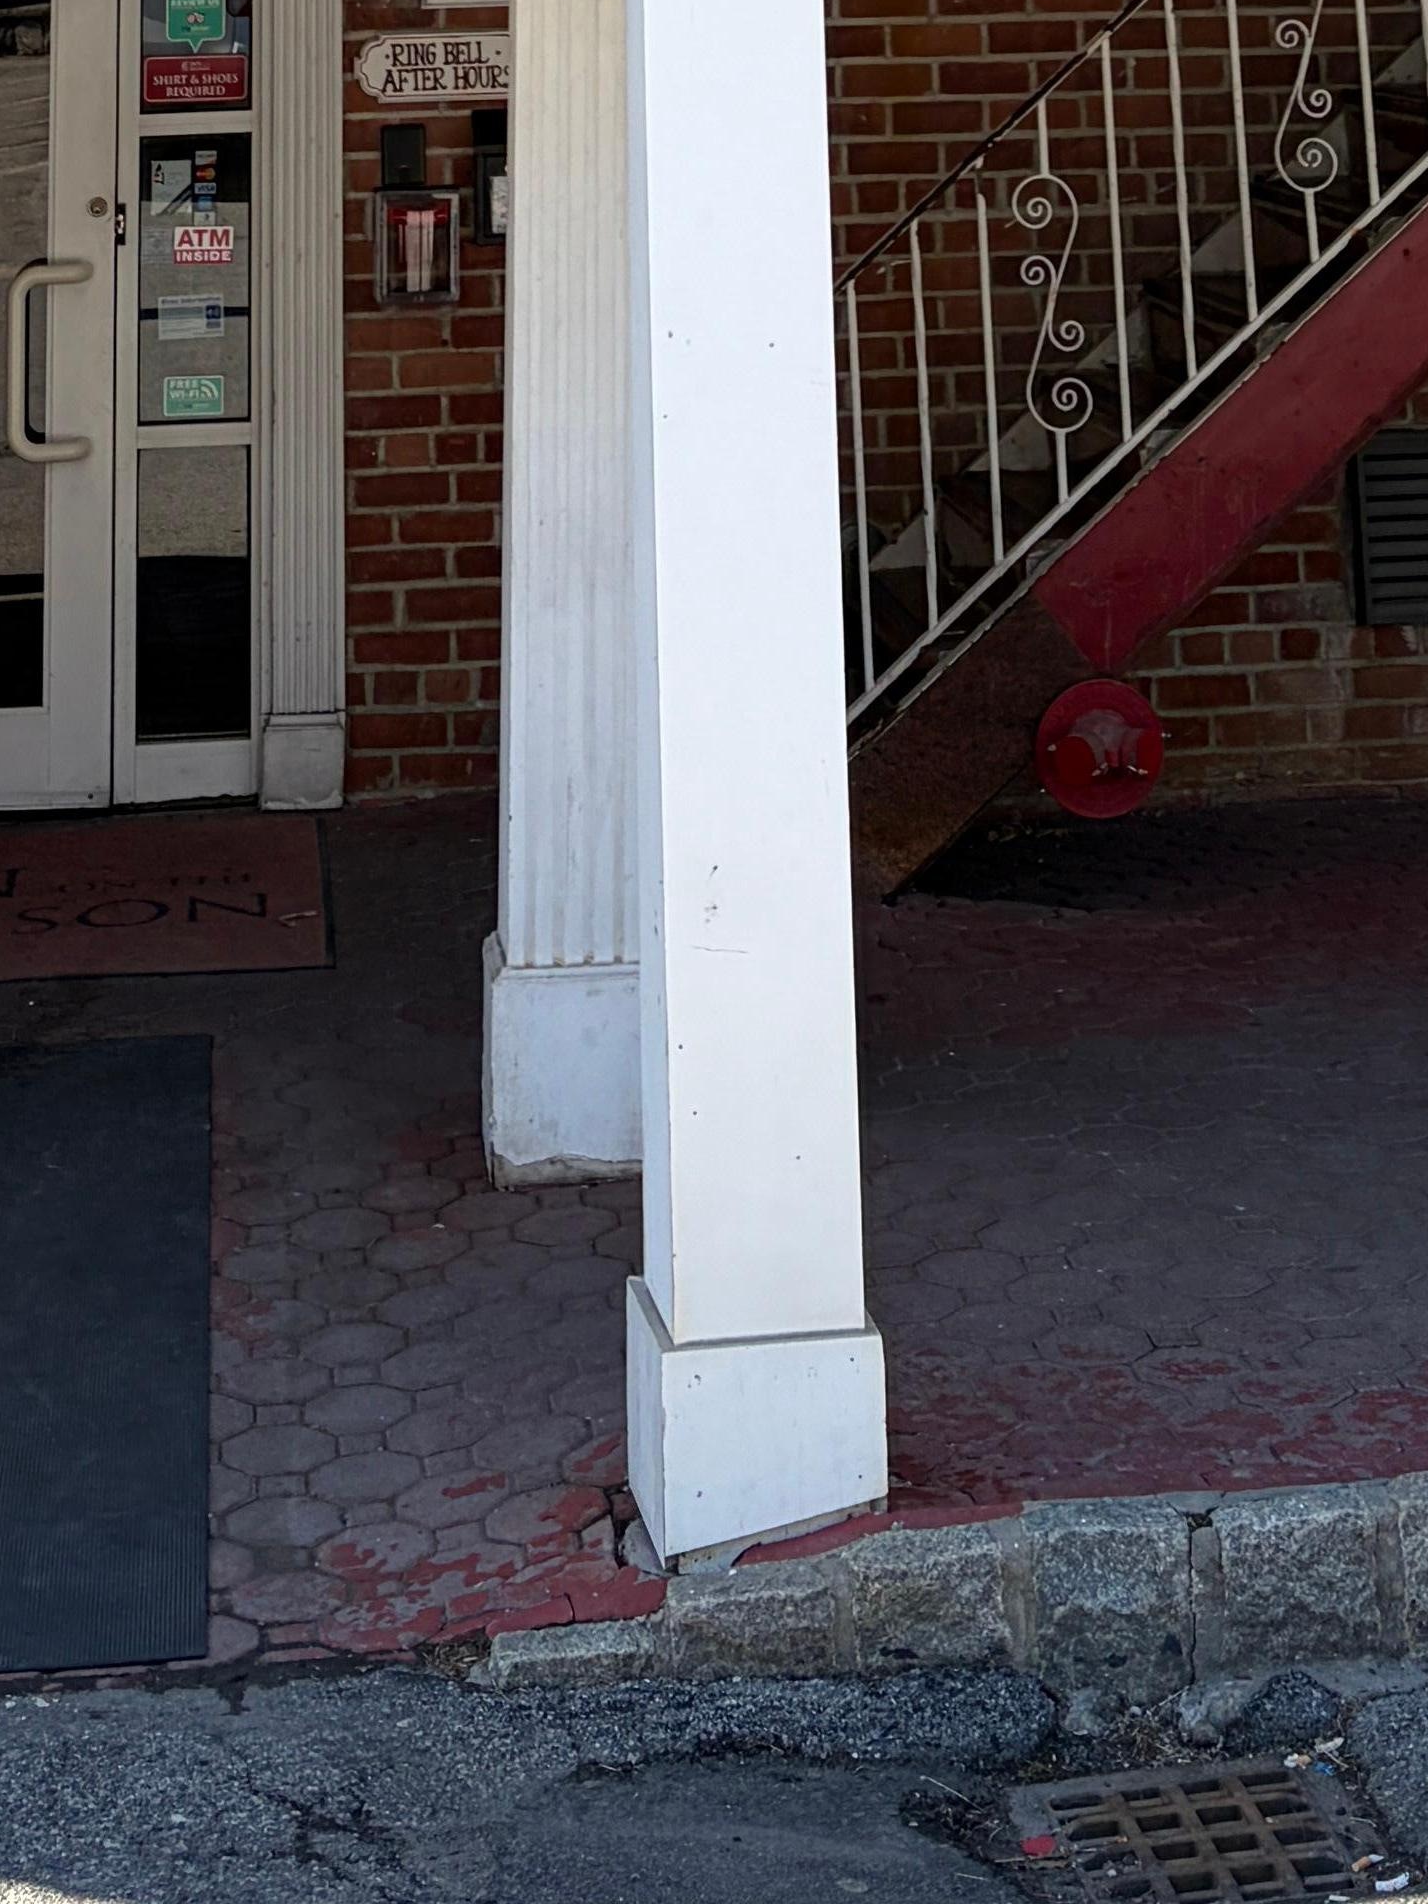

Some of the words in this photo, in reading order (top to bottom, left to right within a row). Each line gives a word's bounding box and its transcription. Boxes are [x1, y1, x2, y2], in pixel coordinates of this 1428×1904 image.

[390, 42, 437, 67] RING
[442, 40, 490, 65] BELL
[153, 74, 188, 86] SHIRT
[190, 74, 200, 85] &
[202, 72, 239, 84] SHOES
[381, 67, 447, 93] AFTER
[166, 84, 226, 98] REQUIRED
[177, 229, 231, 248] ATM
[176, 250, 232, 262] INSIDE
[169, 379, 199, 389] FREE
